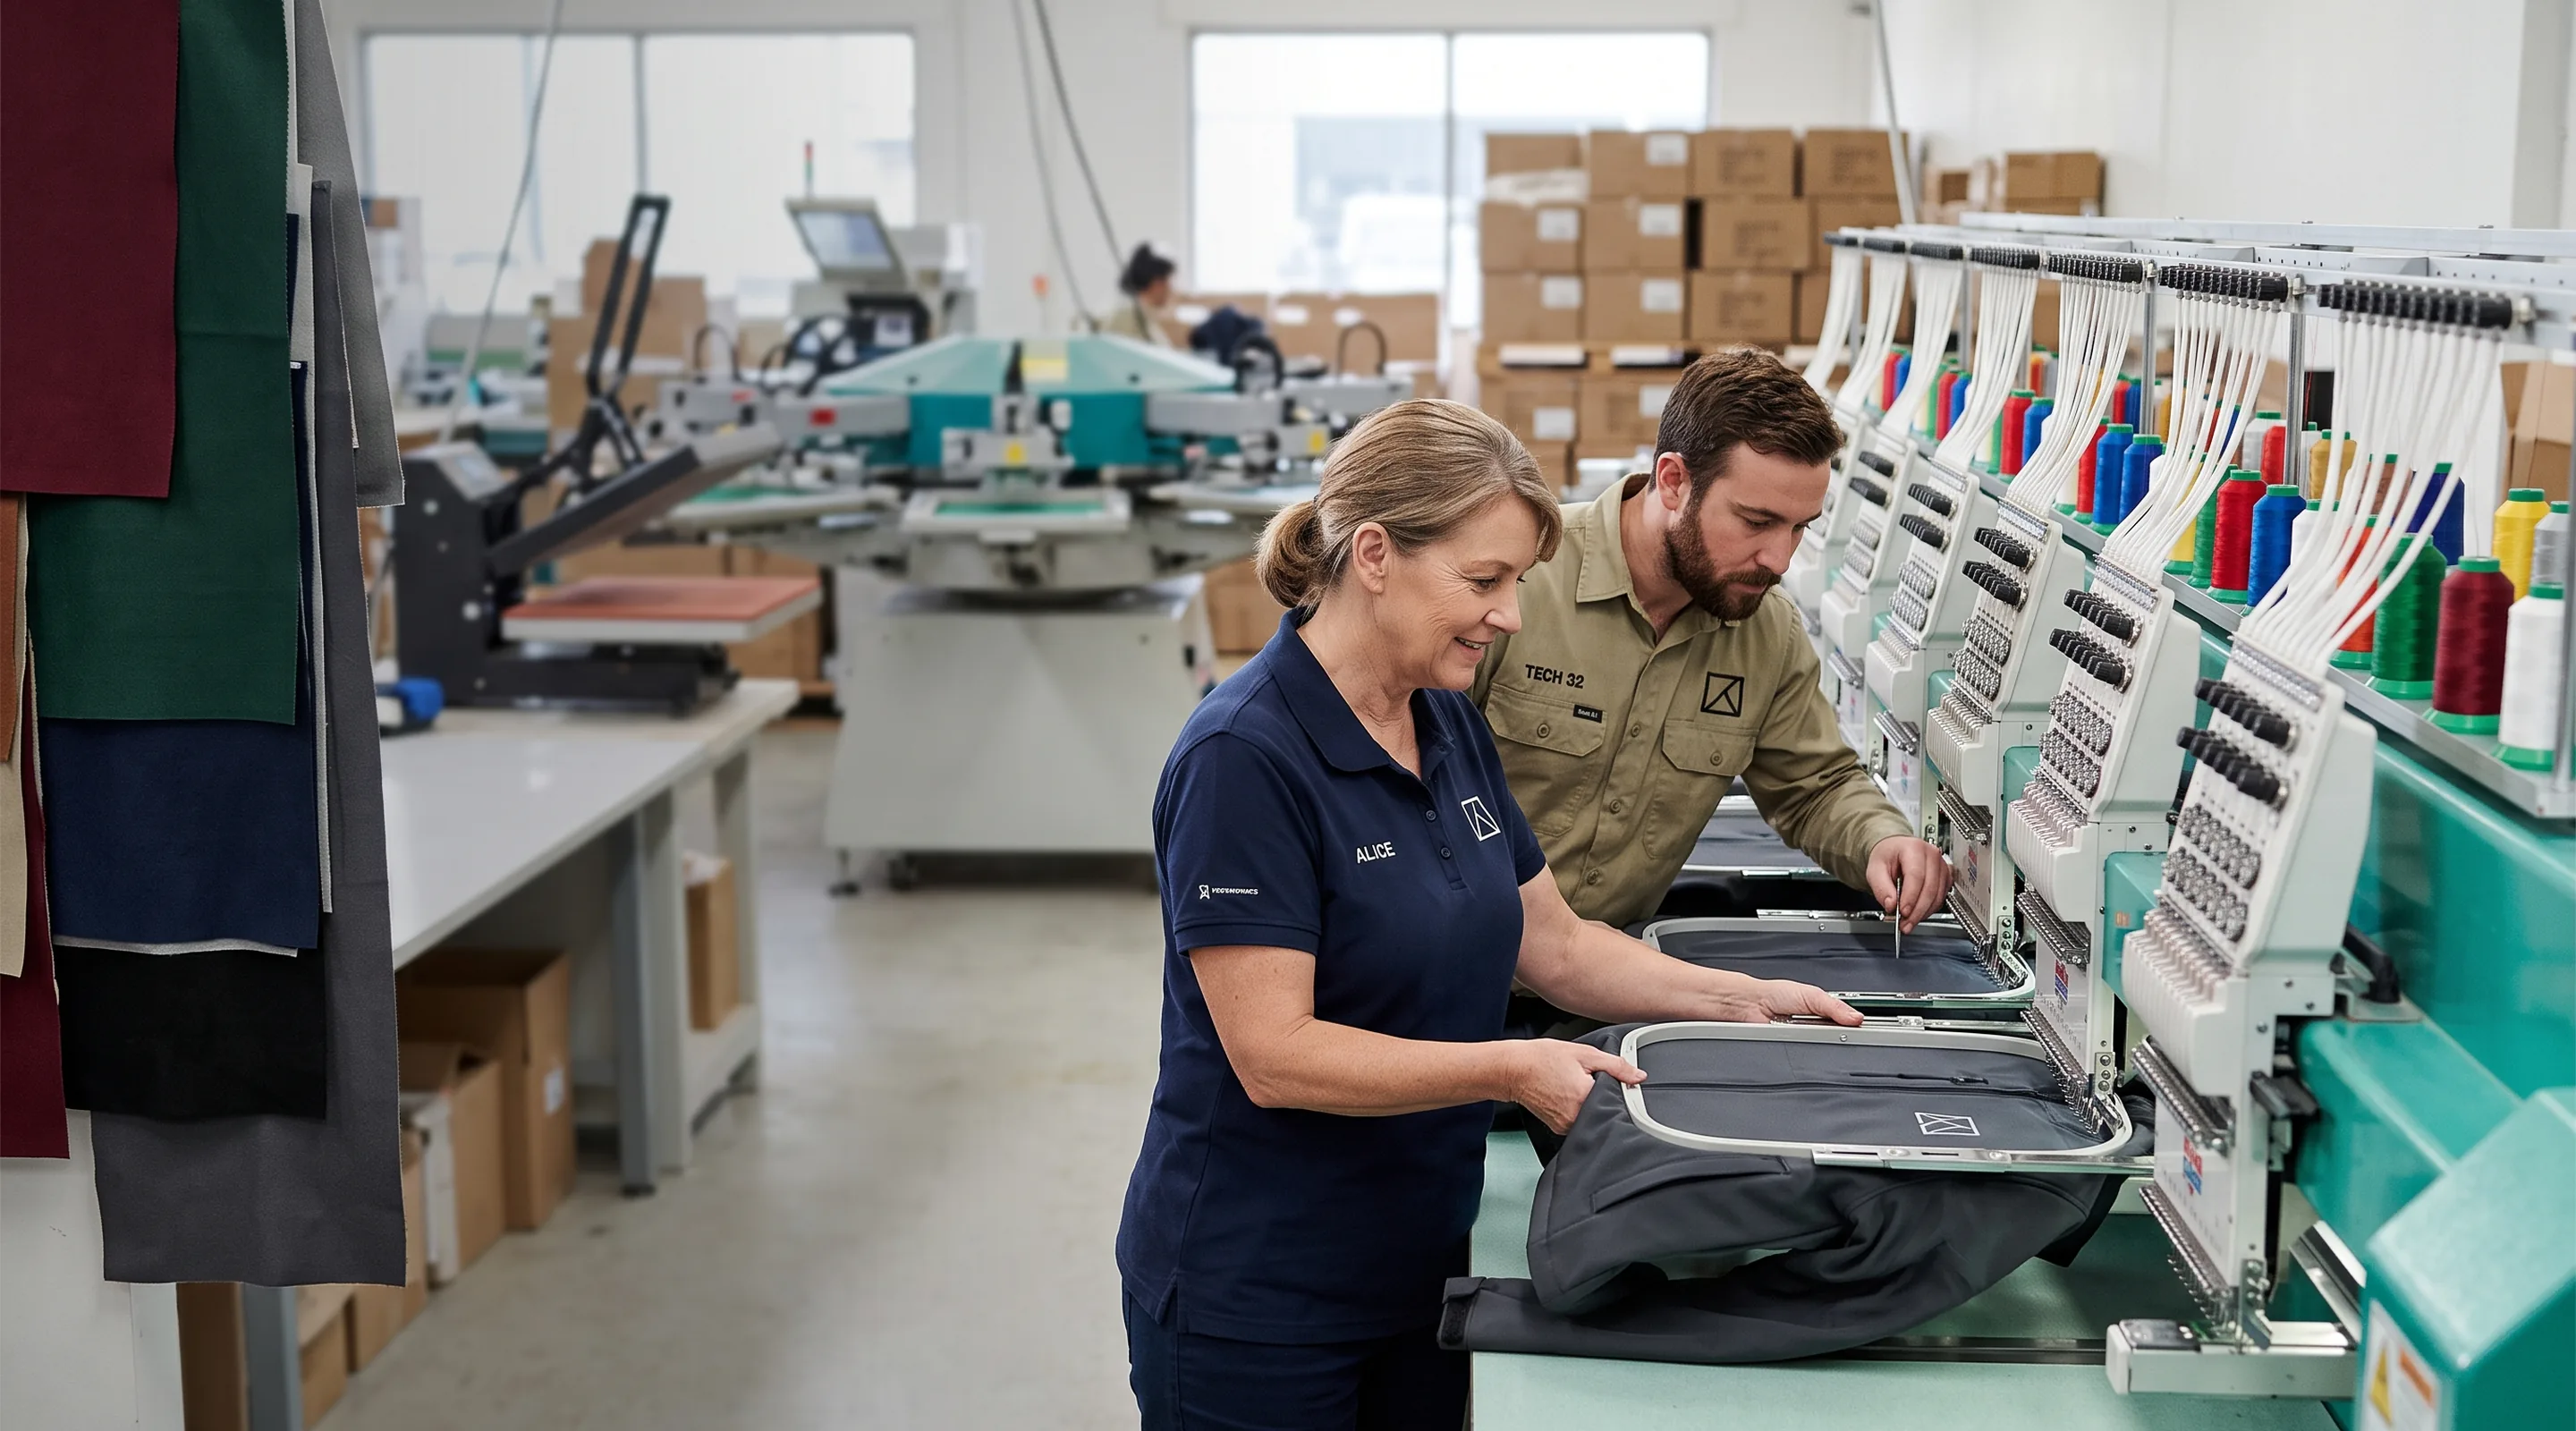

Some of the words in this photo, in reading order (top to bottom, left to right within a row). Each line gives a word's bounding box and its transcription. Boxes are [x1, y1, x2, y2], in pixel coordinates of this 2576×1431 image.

[1525, 664, 1563, 684] TECH
[1566, 673, 1584, 689] 32
[1356, 841, 1396, 864] ALICE
